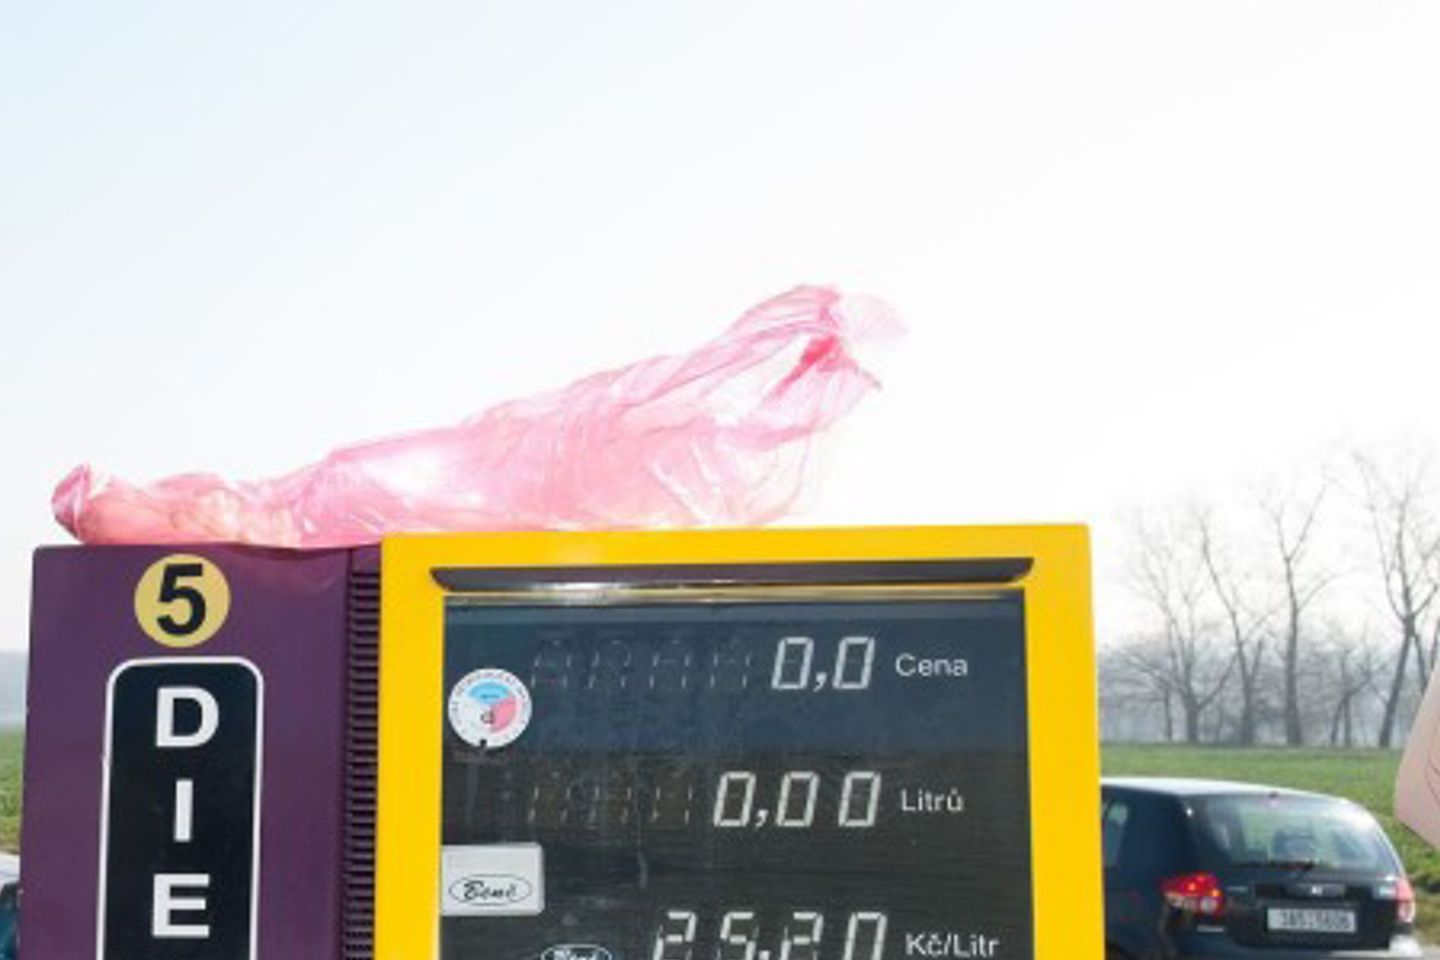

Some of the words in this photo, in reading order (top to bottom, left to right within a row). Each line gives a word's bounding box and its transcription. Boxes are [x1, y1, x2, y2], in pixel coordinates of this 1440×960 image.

[156, 563, 207, 636] 5
[771, 636, 876, 692] 0,0
[895, 653, 969, 677] Cena
[900, 788, 965, 812] Litrů
[905, 932, 999, 958] Kč/Litr
